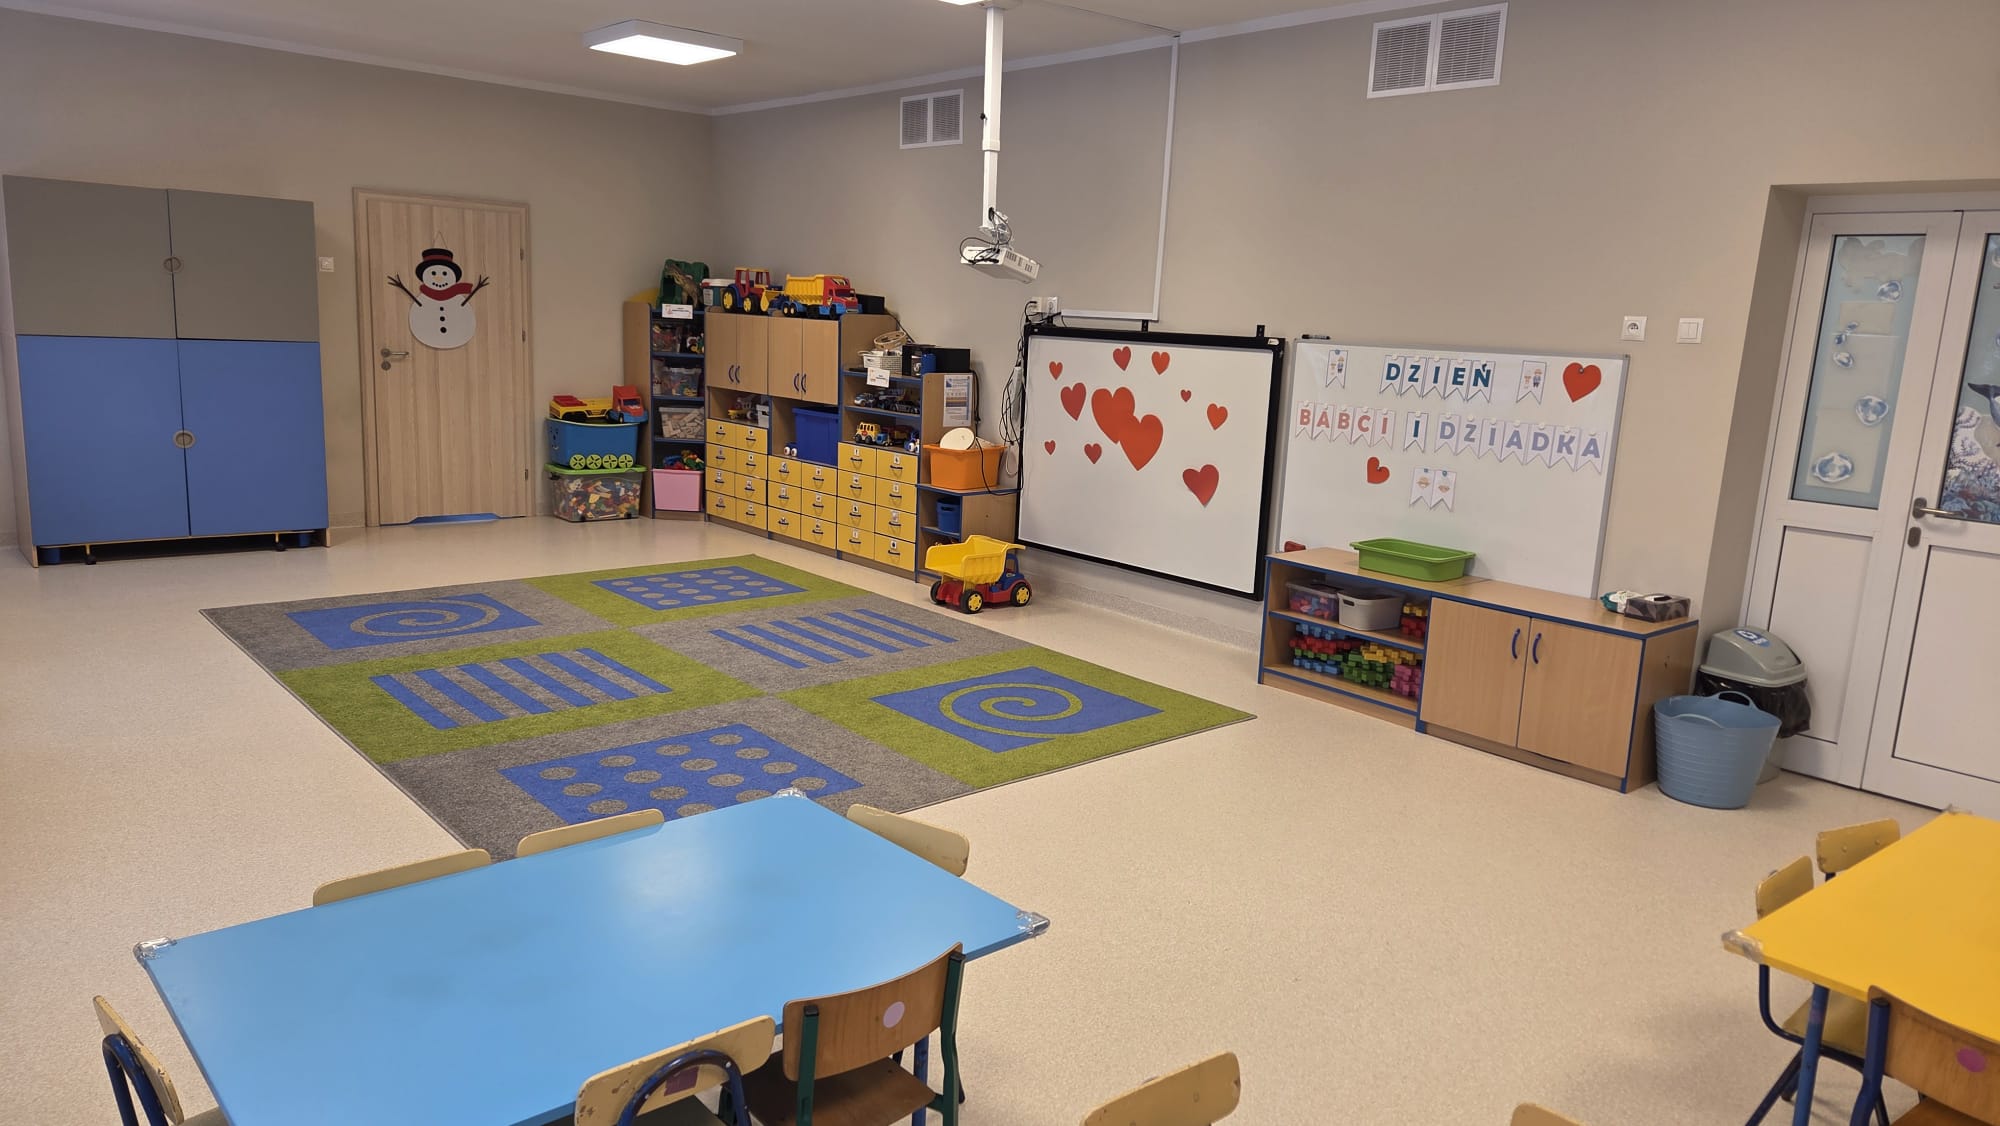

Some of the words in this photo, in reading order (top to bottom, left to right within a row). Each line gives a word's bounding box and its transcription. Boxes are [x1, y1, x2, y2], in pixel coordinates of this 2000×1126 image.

[1385, 362, 1491, 388] DZIEŃ
[1413, 420, 1420, 438] I
[1439, 421, 1601, 459] DZIADKA
